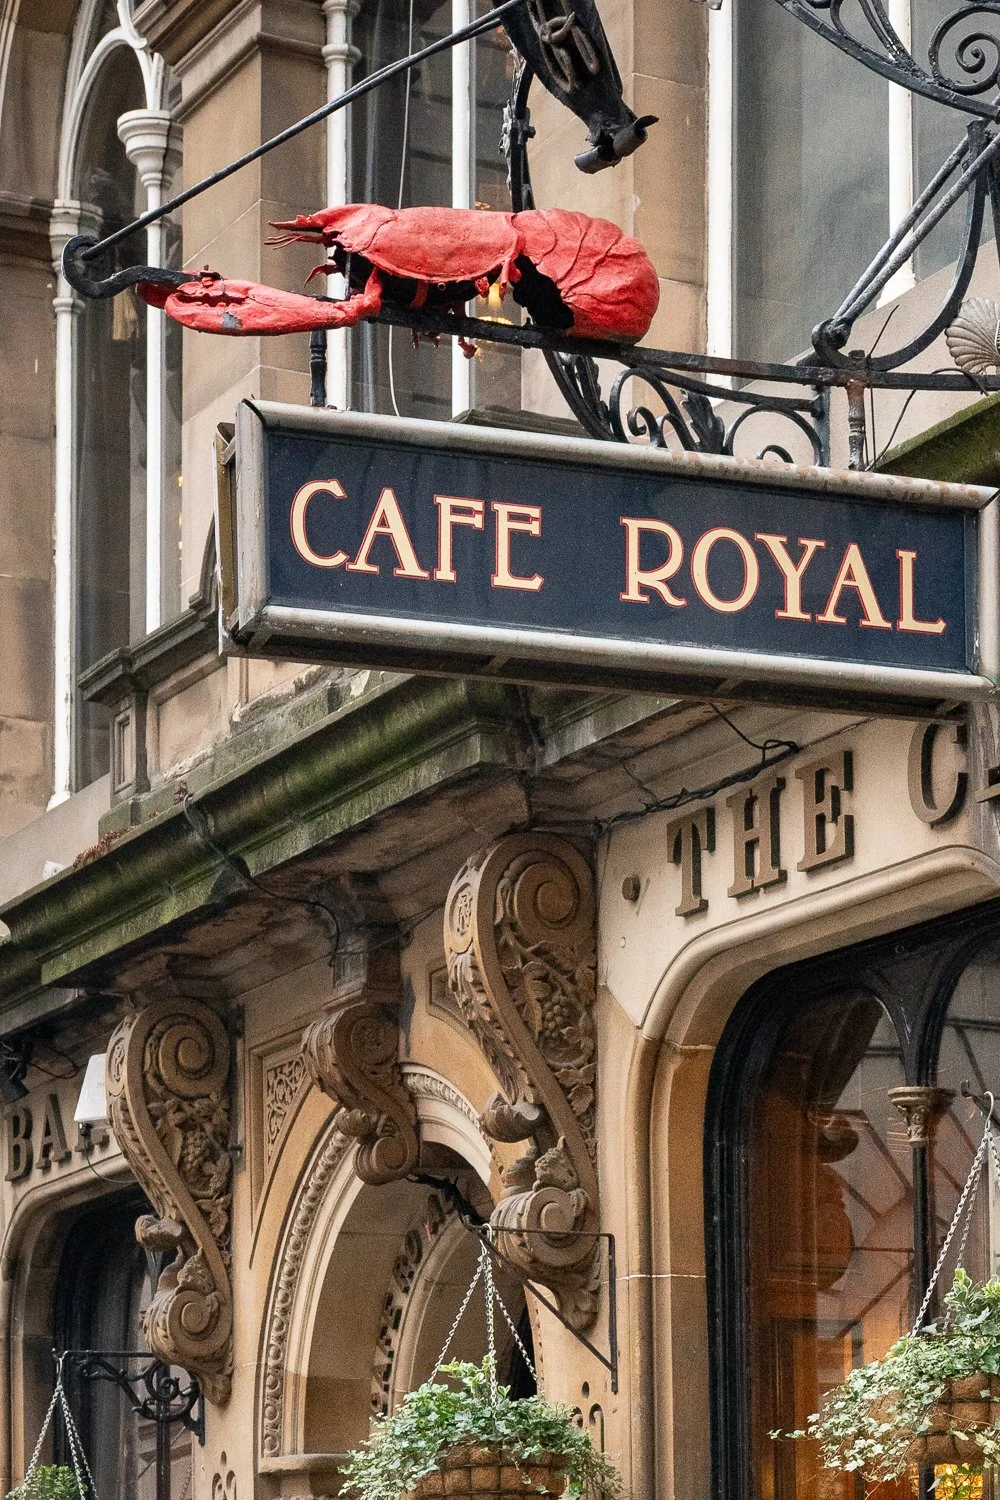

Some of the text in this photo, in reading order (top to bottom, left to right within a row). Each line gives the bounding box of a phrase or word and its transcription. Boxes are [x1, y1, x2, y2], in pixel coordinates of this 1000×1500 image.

[290, 478, 948, 635] CAFE ROYAL
[666, 750, 855, 918] THE
